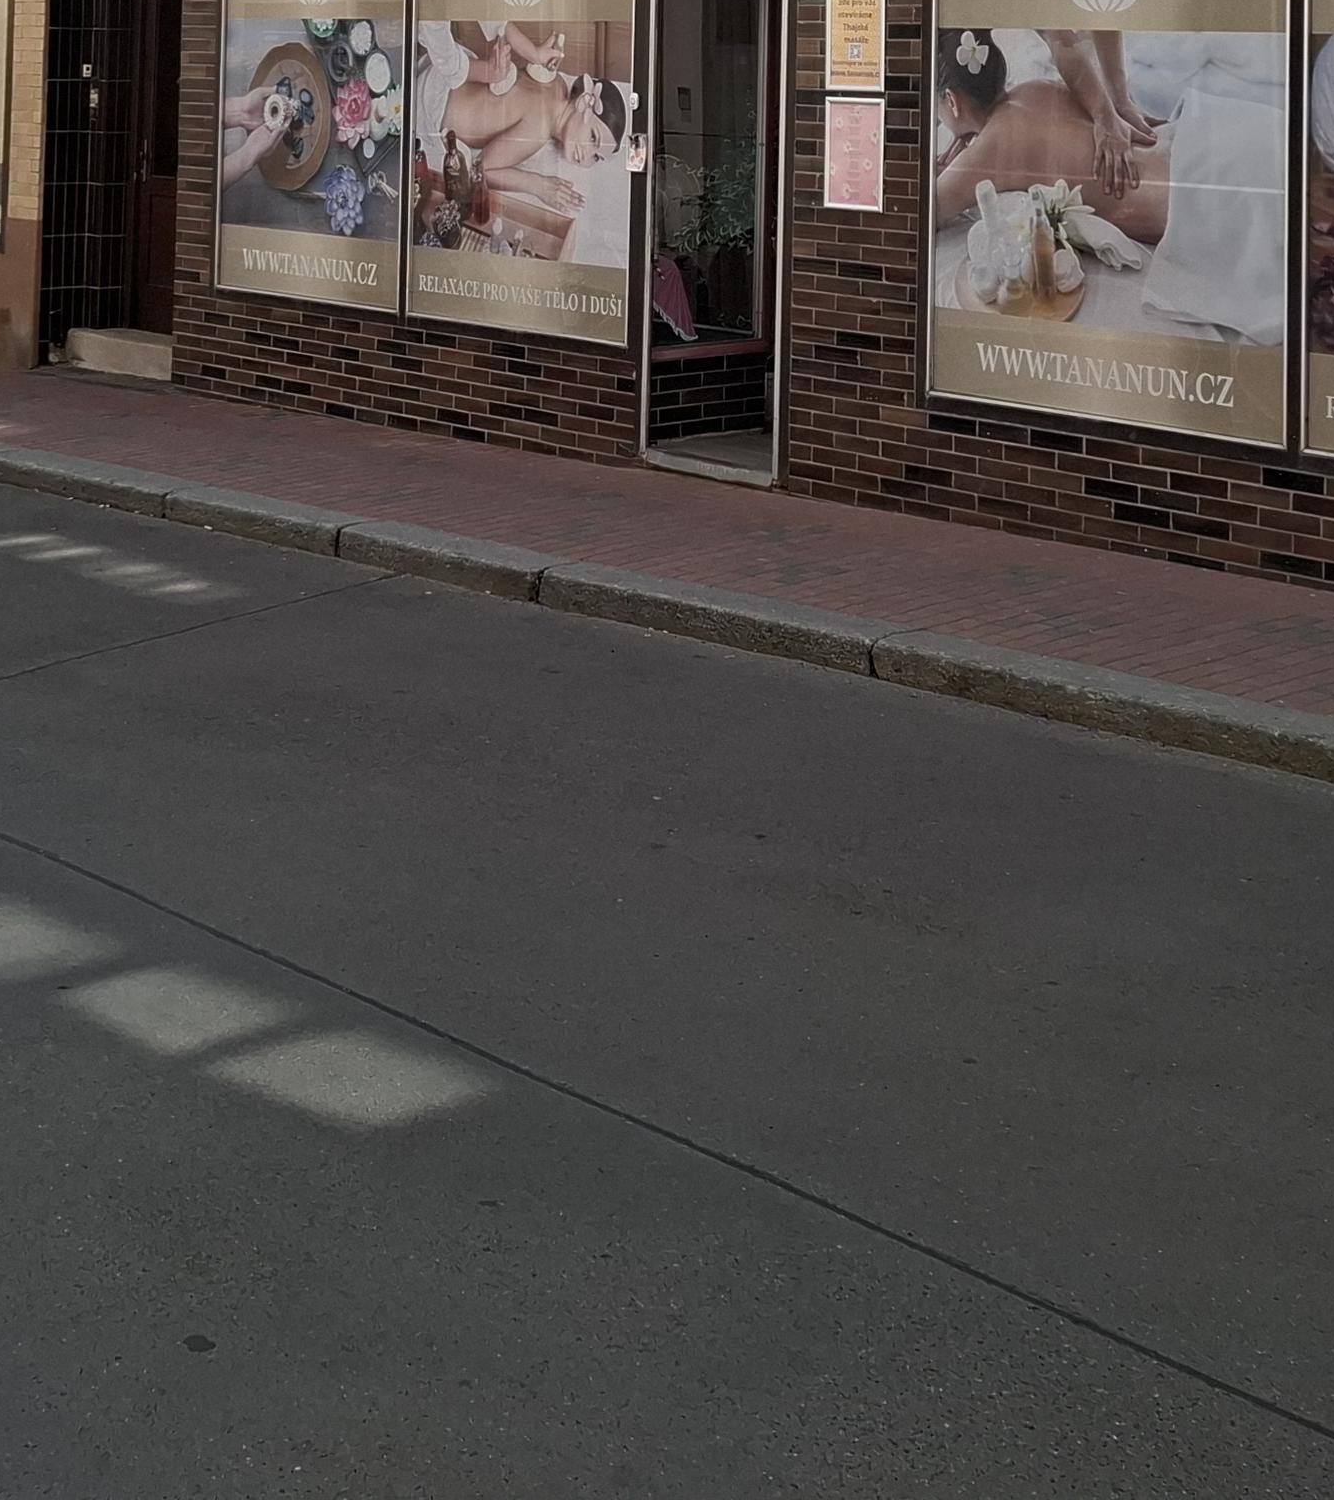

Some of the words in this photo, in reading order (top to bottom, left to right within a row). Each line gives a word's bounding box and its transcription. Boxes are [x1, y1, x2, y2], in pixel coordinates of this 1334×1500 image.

[243, 248, 378, 286] WWW.TANANUN.CZ
[418, 274, 481, 298] RELAXACE
[483, 283, 508, 302] PRO
[511, 284, 541, 306] VAŠE
[544, 287, 578, 311] TĚLO
[582, 295, 587, 313] I
[590, 293, 623, 317] DUŠI
[976, 342, 1235, 409] WWW.TANANUN.CZ
